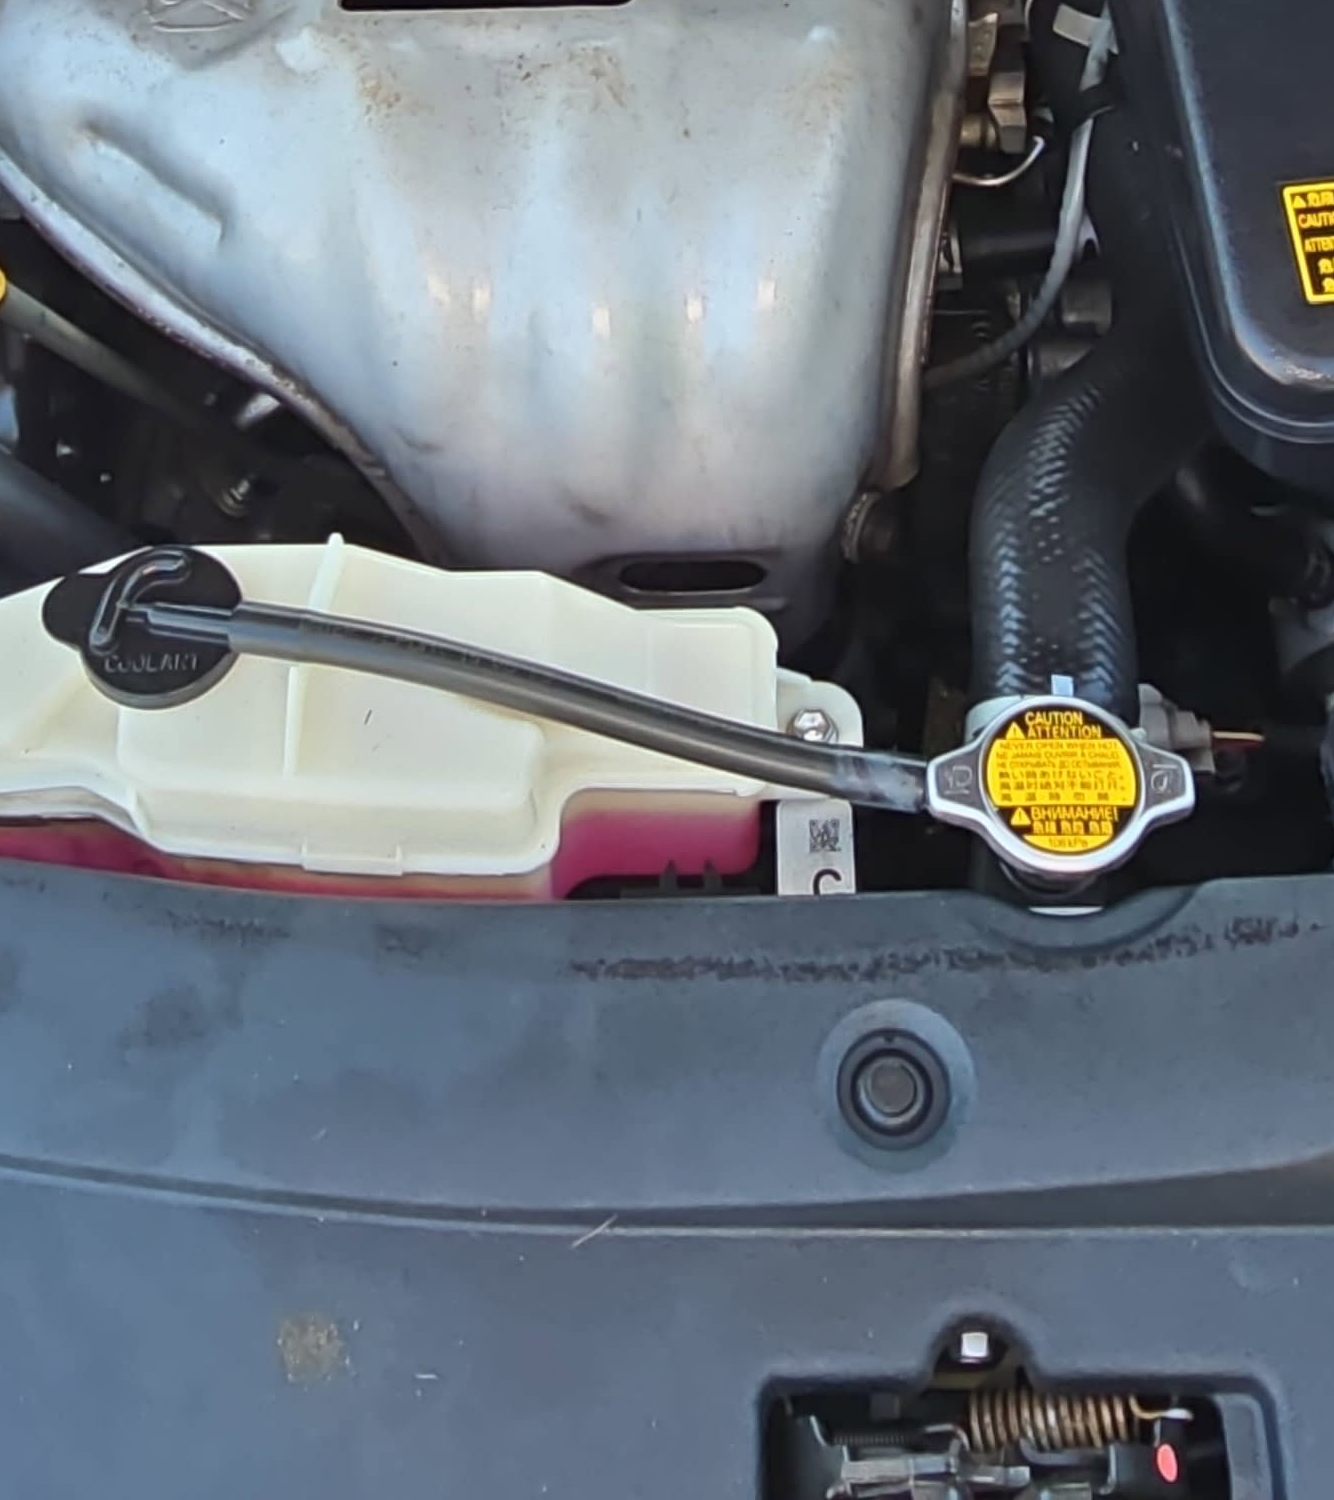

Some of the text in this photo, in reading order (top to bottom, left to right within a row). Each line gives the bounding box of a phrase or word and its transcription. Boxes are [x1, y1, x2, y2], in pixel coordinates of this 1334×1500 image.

[104, 652, 199, 674] COOLANT
[1024, 710, 1084, 725] CAUTION
[1027, 724, 1102, 739] ATTENTION
[999, 741, 1034, 750] NEVER
[1035, 741, 1064, 750] OPEN
[1066, 741, 1096, 750] WHEN
[1030, 806, 1119, 822] ВНИМАНИЕ!
